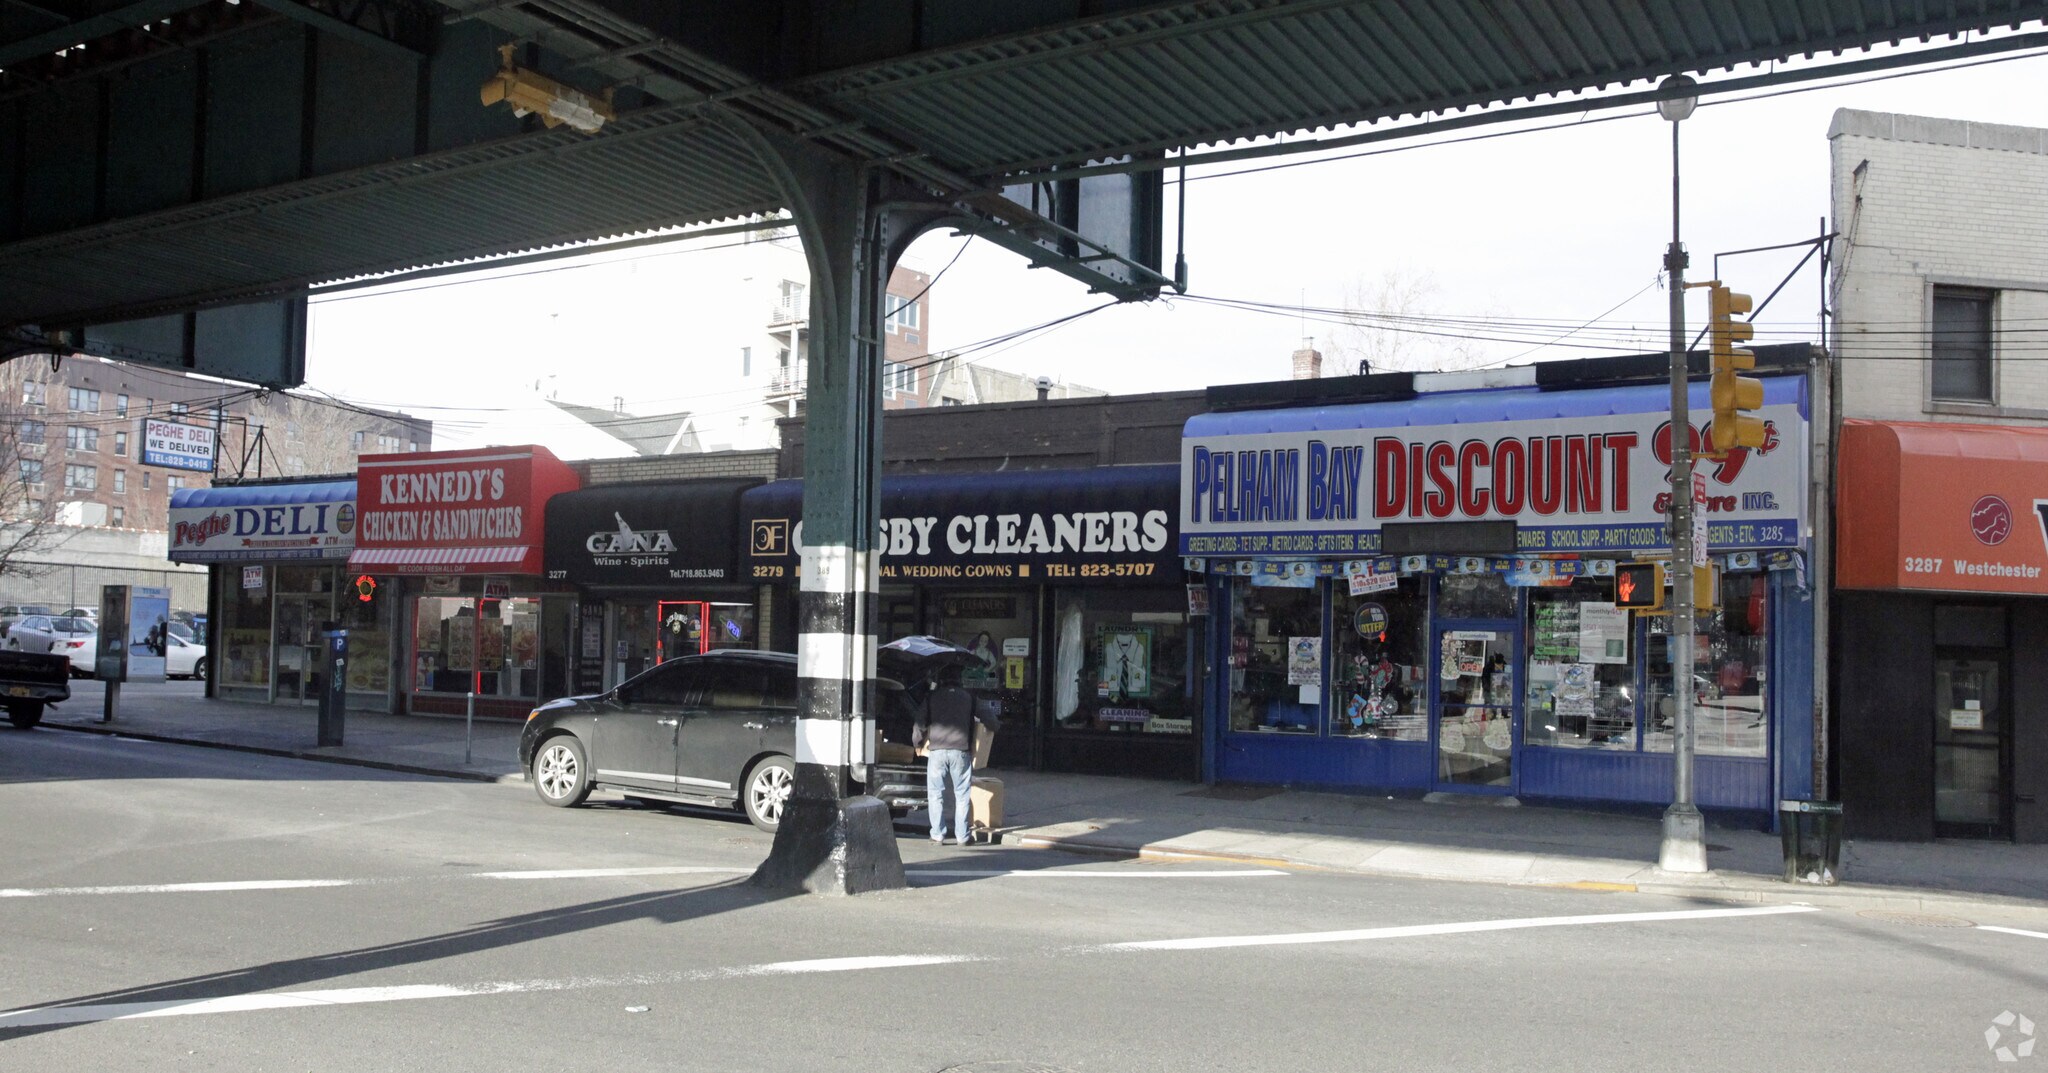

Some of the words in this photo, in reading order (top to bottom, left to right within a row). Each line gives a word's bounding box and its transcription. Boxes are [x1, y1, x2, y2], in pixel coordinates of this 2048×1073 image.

[148, 422, 184, 440] PEGHE
[188, 428, 212, 444] DELI
[149, 438, 165, 449] WE
[169, 441, 210, 455] DELIVER
[1192, 446, 1299, 523] PELHAM
[1307, 440, 1364, 521] BAY
[1373, 431, 1639, 519] DISCOUNT
[380, 468, 505, 504] KENNEDY'S
[1742, 491, 1779, 511] INC.
[173, 511, 231, 547] Peghe
[233, 504, 330, 536] DELI
[363, 509, 419, 541] CHICKEN
[420, 510, 431, 541] &
[433, 506, 522, 541] SANDWICHES
[945, 510, 1168, 555] CLEANERS
[1189, 537, 1216, 551] GREETING
[1217, 536, 1237, 551] CARDS
[1252, 536, 1268, 551] SUPP.
[1272, 536, 1293, 551] METRO
[1293, 535, 1314, 550] CARDS
[1318, 535, 1334, 550] GIFTS
[1335, 534, 1354, 550] ITEMS
[1358, 534, 1382, 550] HEALTH
[1517, 531, 1546, 548] EWARES
[1552, 529, 1580, 547] SCHOOL
[1581, 528, 1600, 546] SUPP.
[1605, 528, 1628, 546] PARTY
[1629, 527, 1656, 546] GOODS
[1706, 525, 1734, 544] GENTS
[1739, 525, 1756, 543] ETC.
[1760, 527, 1783, 542] 3285
[324, 536, 339, 545] ATM
[586, 532, 678, 553] GANA
[594, 557, 622, 566] Wine
[630, 556, 669, 567] Spirits
[1905, 557, 1943, 573] 3287
[1953, 560, 2041, 578] Westchester
[246, 571, 262, 579] ATM
[406, 565, 423, 573] COOK
[424, 565, 443, 573] FRESH
[443, 565, 454, 573] ALL
[455, 565, 466, 573] DAY
[549, 570, 567, 579] 3277
[670, 569, 725, 578] Tel.718.863.9463
[753, 566, 784, 577] 3279
[903, 565, 962, 577] WEDDING
[965, 565, 1012, 577] GOWNS
[1046, 564, 1075, 577] TEL:
[1080, 563, 1155, 576] 823-5707
[485, 584, 508, 596] ATM
[726, 619, 740, 638] OPEN
[1358, 621, 1386, 633] LOTTERY
[337, 639, 344, 650] P
[1461, 662, 1482, 673] OPEN
[1100, 708, 1150, 717] CLEANING
[1166, 722, 1192, 731] Storage
